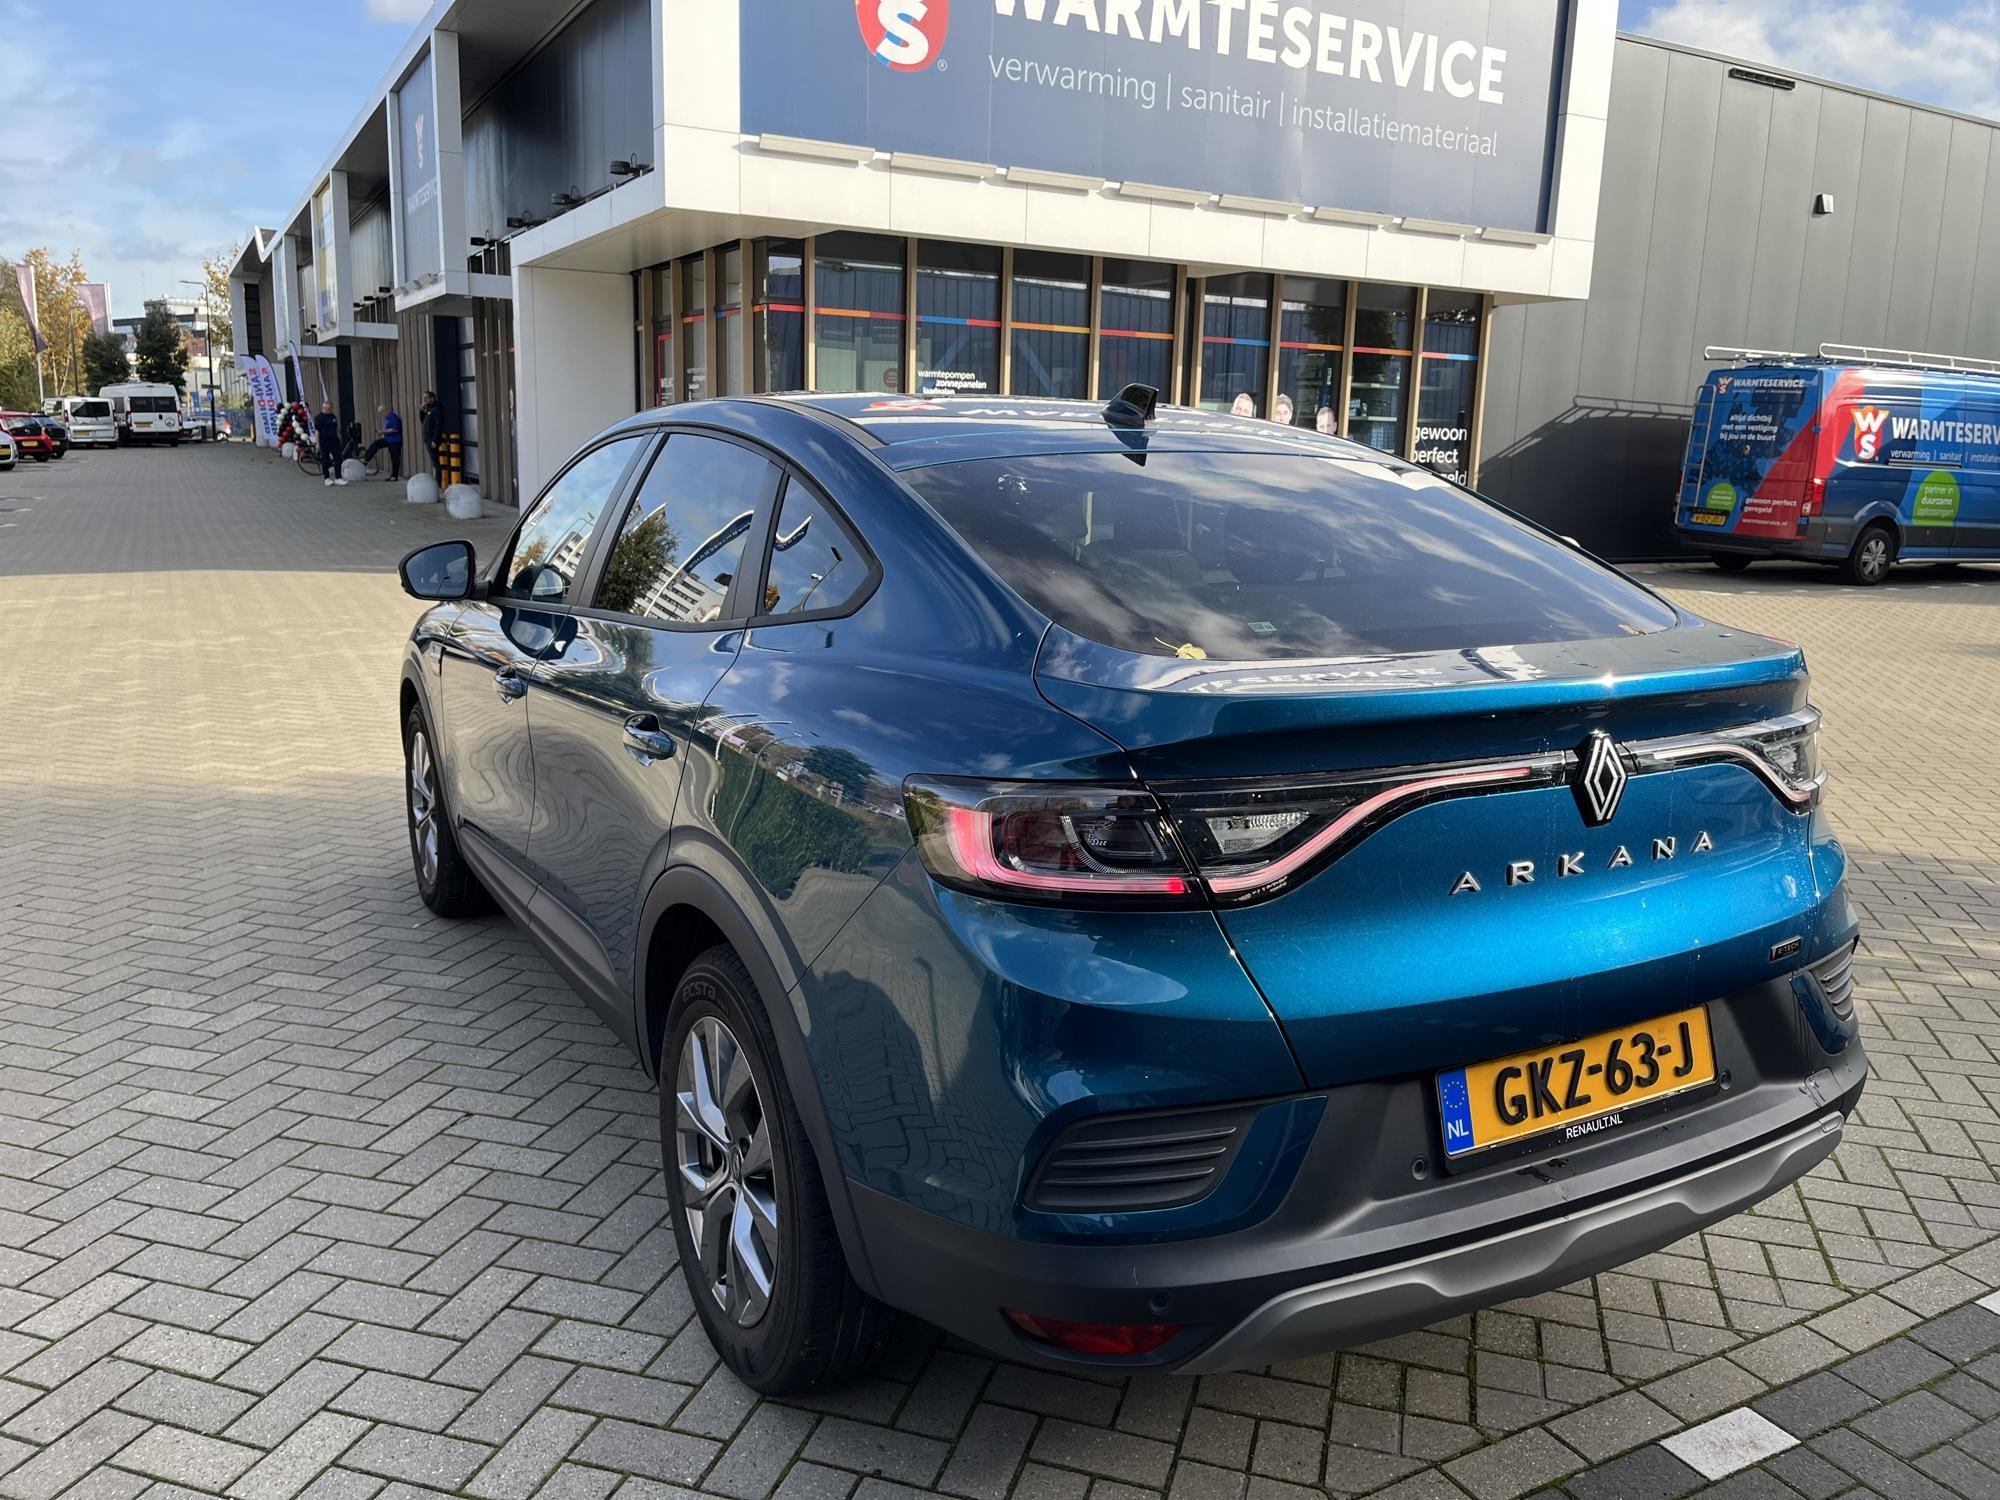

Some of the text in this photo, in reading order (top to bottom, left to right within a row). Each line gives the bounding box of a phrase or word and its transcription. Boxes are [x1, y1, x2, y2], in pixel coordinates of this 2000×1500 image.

[994, 0, 1507, 104] RMTESERVICE
[988, 54, 1498, 157] verwarming sanitair installatiemateriaal
[917, 370, 976, 380] warmtepompen
[935, 380, 988, 389] zonnepanelen
[1733, 378, 1805, 388] WARMTESERVICE
[1747, 414, 1773, 423] dichtbij
[1748, 425, 1779, 433] vestiging
[1891, 416, 2000, 446] WARMTESERV
[1757, 433, 1776, 441] buurt
[1890, 450, 1931, 461] verwarming
[1939, 451, 1962, 461] sanitair
[1772, 498, 1797, 507] perfect
[1448, 830, 1714, 896] ARKANA
[1777, 941, 1800, 955] E-TECH
[1495, 1021, 1695, 1126] GKZ-63-J
[1447, 1118, 1469, 1140] NL
[1566, 1113, 1624, 1140] RENAULT.NL
